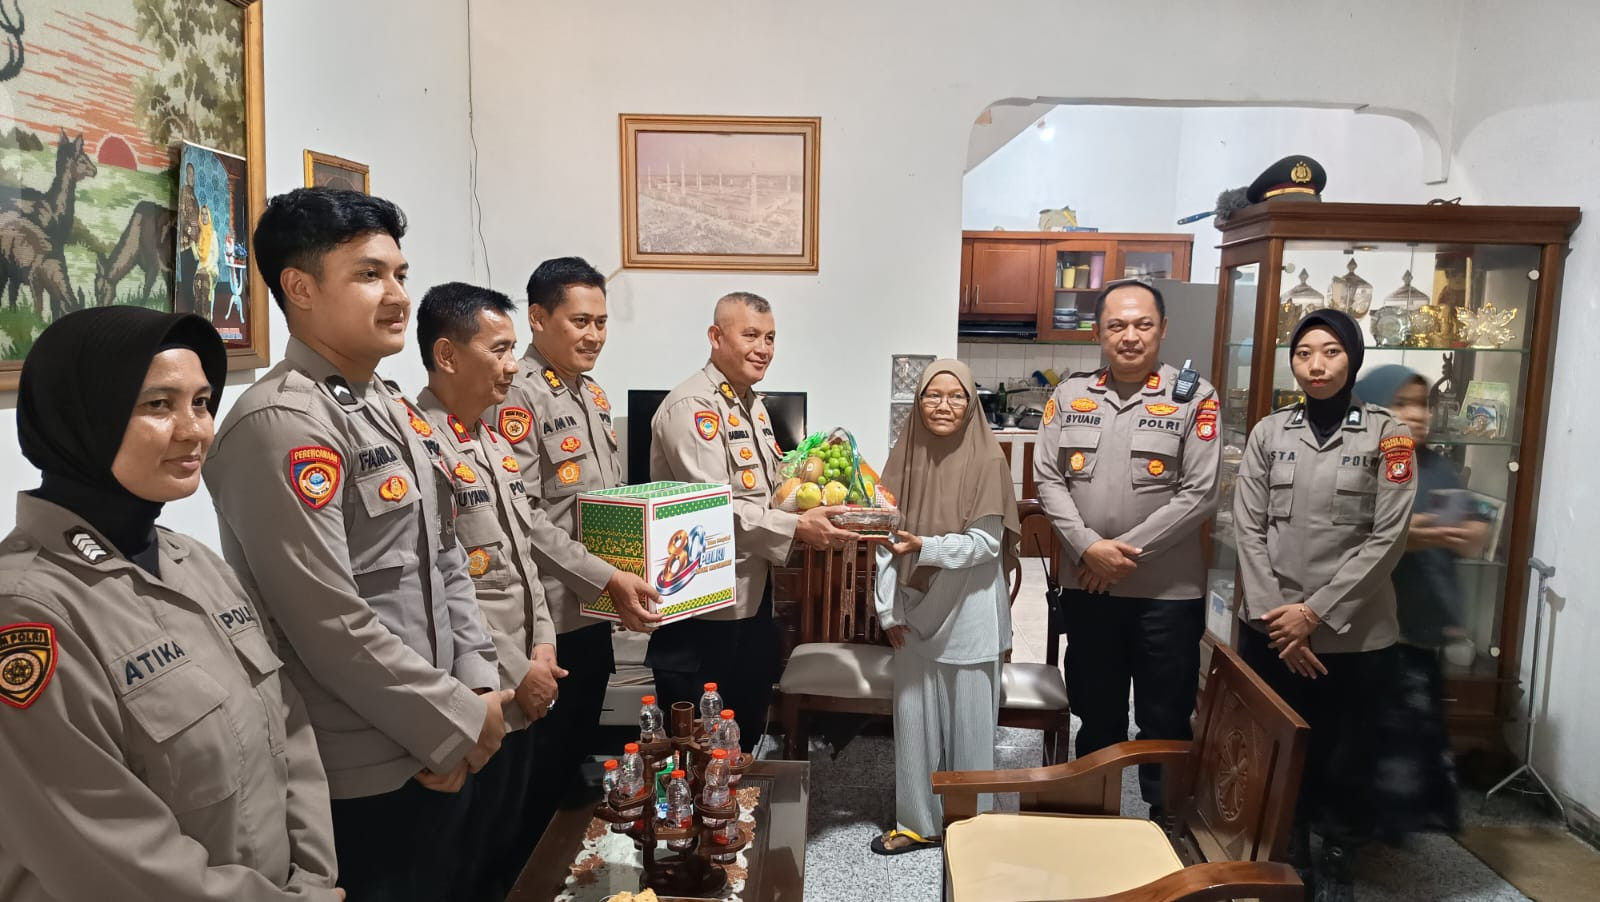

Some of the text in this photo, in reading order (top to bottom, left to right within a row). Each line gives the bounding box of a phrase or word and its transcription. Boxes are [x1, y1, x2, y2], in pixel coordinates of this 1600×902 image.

[1066, 414, 1101, 425] SYUAIB
[1138, 418, 1180, 431] POLRI
[125, 640, 186, 685] ATIKA
